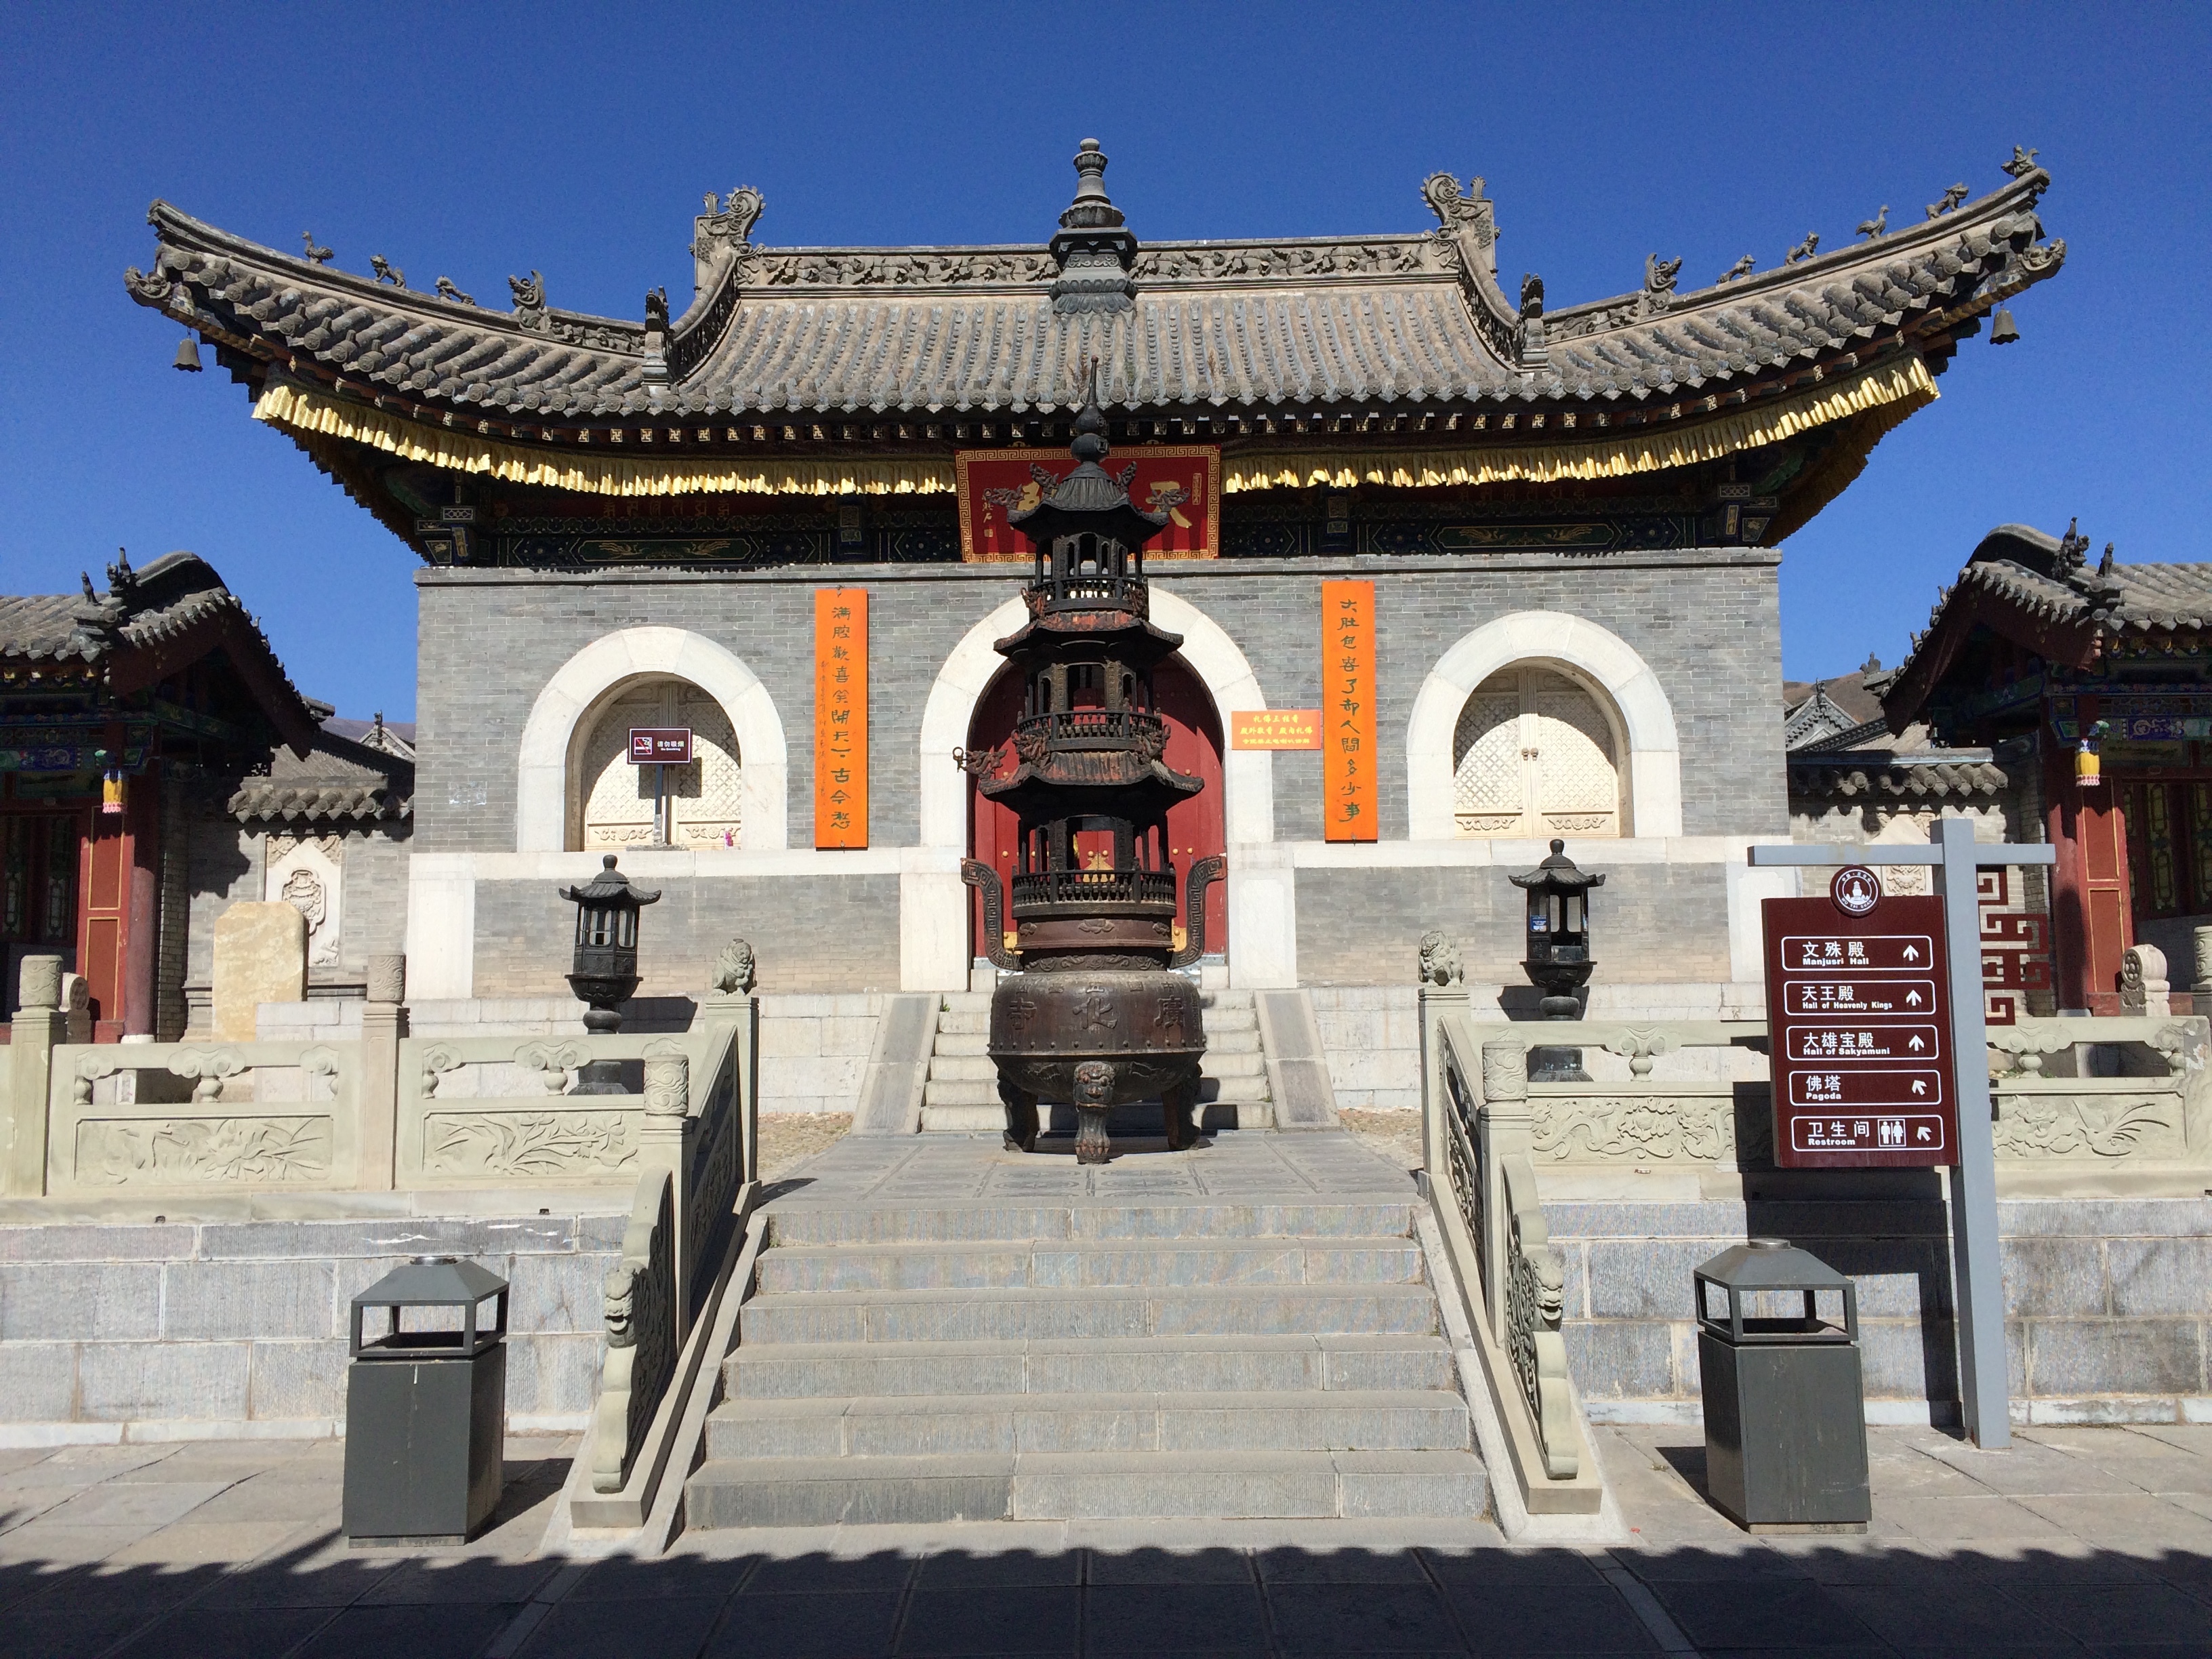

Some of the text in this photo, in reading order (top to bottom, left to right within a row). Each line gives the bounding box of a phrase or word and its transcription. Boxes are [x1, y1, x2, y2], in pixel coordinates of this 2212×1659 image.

[1803, 941, 1864, 957] 文殊殿
[1803, 958, 1844, 966] Manjusri
[1802, 985, 1854, 1001] 天王殿
[1833, 1002, 1868, 1010] Heavenly
[1871, 1001, 1893, 1010] Kings
[1803, 1031, 1874, 1048] 大雄宝殿
[1839, 1047, 1890, 1057] Sakyamuni
[1806, 1075, 1841, 1092] 佛塔
[1806, 1092, 1842, 1101] Pagoda
[1807, 1120, 1870, 1137] 卫生间
[1808, 1138, 1856, 1146] Restroom
